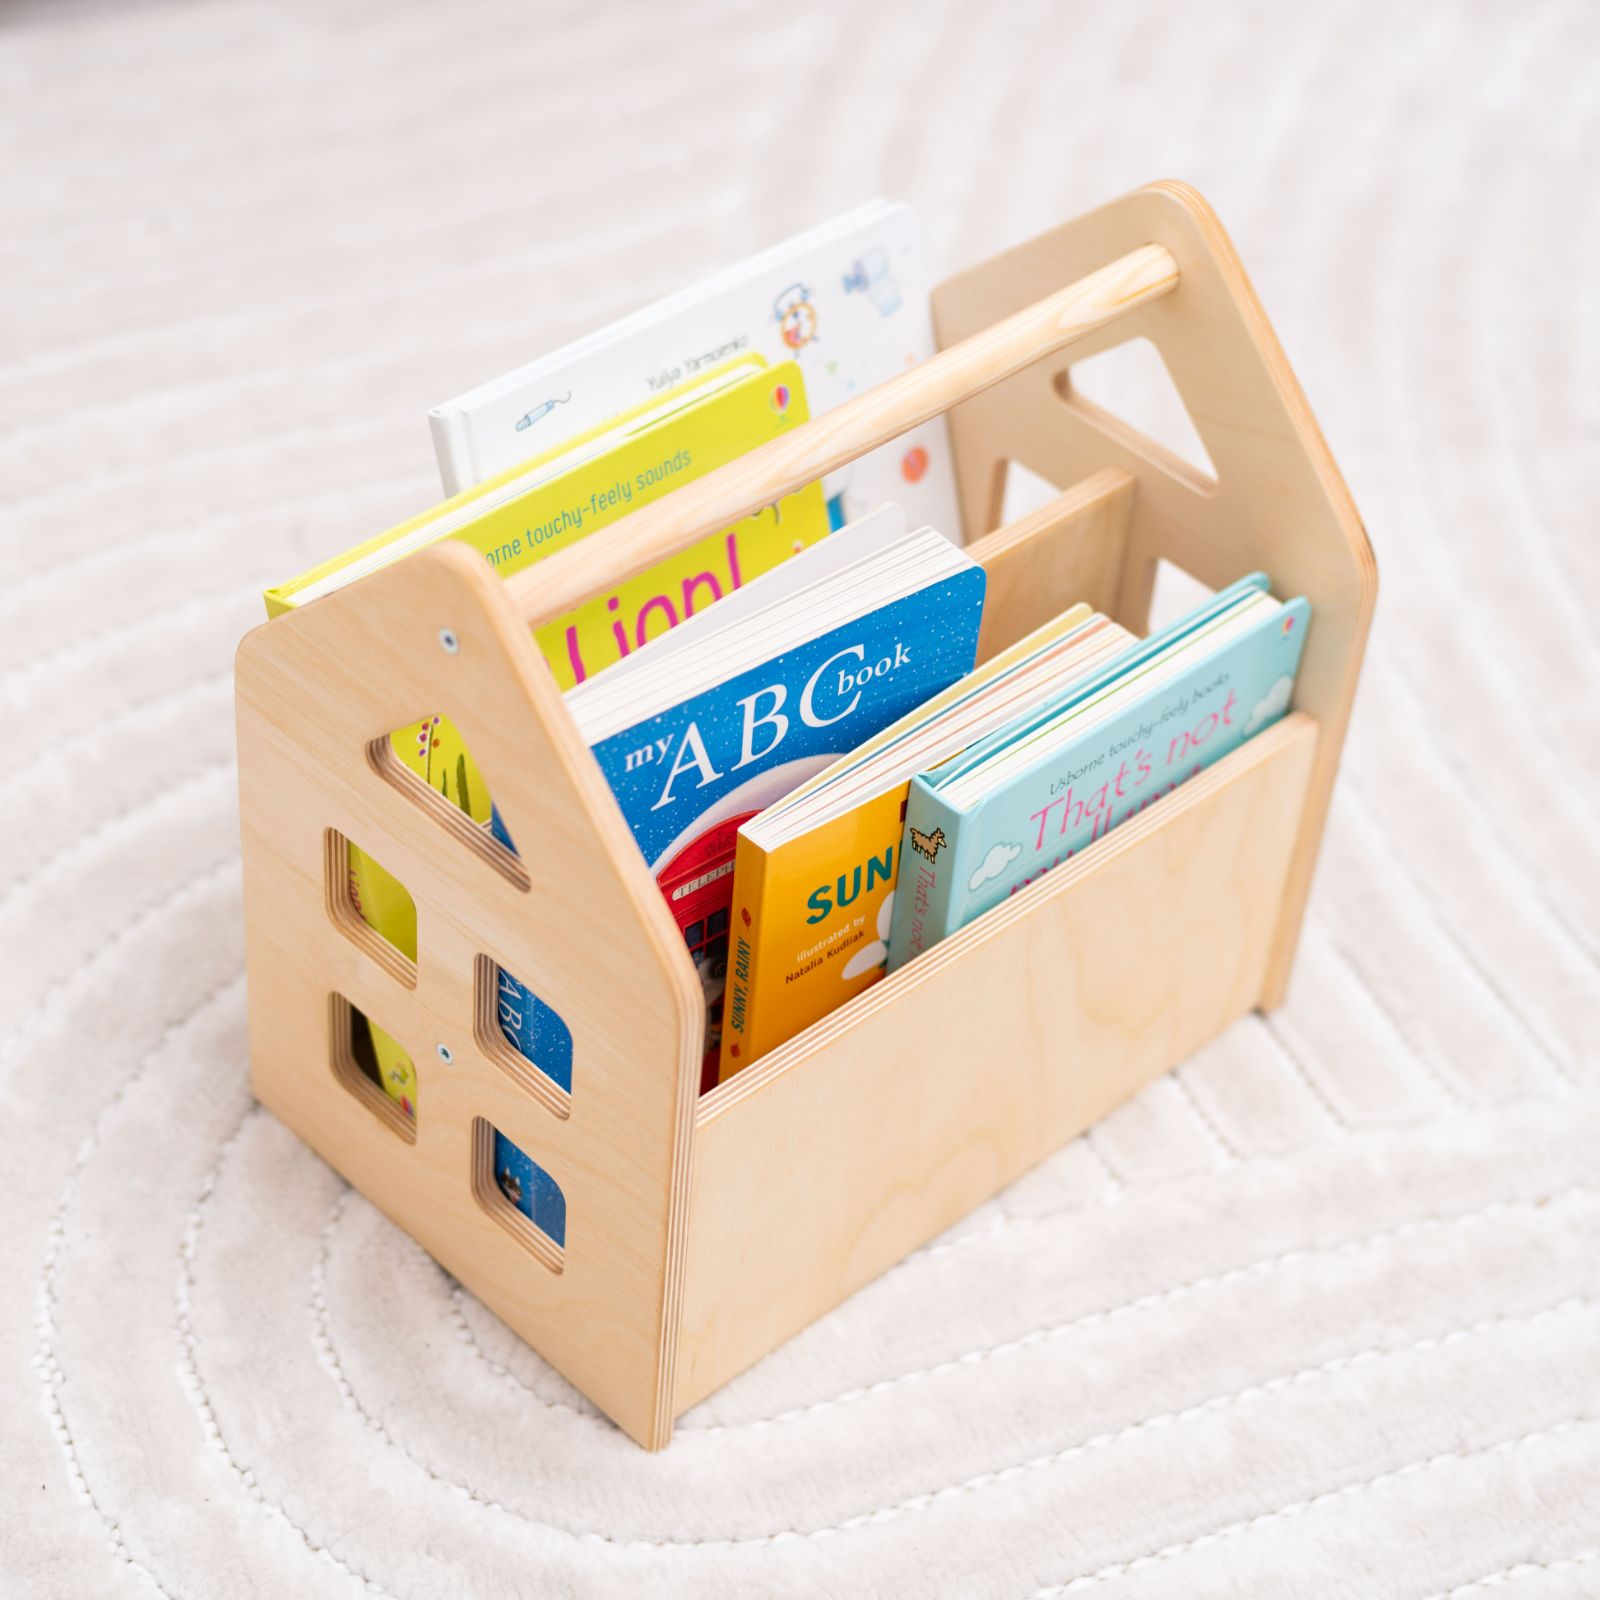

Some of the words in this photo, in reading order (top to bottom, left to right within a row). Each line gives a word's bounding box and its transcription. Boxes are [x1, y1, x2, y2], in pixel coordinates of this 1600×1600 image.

[485, 538, 522, 569] orne
[525, 482, 633, 549] touchy-feely
[635, 449, 693, 492] sounds
[625, 732, 675, 773] my
[650, 643, 865, 813] ABC
[837, 642, 912, 697] book
[1030, 747, 1153, 851] That's
[1165, 687, 1238, 767] not
[1049, 754, 1106, 796] Usborne
[676, 858, 737, 897] TELEPH
[805, 845, 895, 926] SUN
[734, 935, 752, 983] RAINY
[784, 956, 824, 985] Natalia
[826, 929, 865, 960] Kudliak
[796, 922, 851, 964] illustrated
[852, 913, 866, 929] by
[730, 982, 750, 1035] SUNNY,
